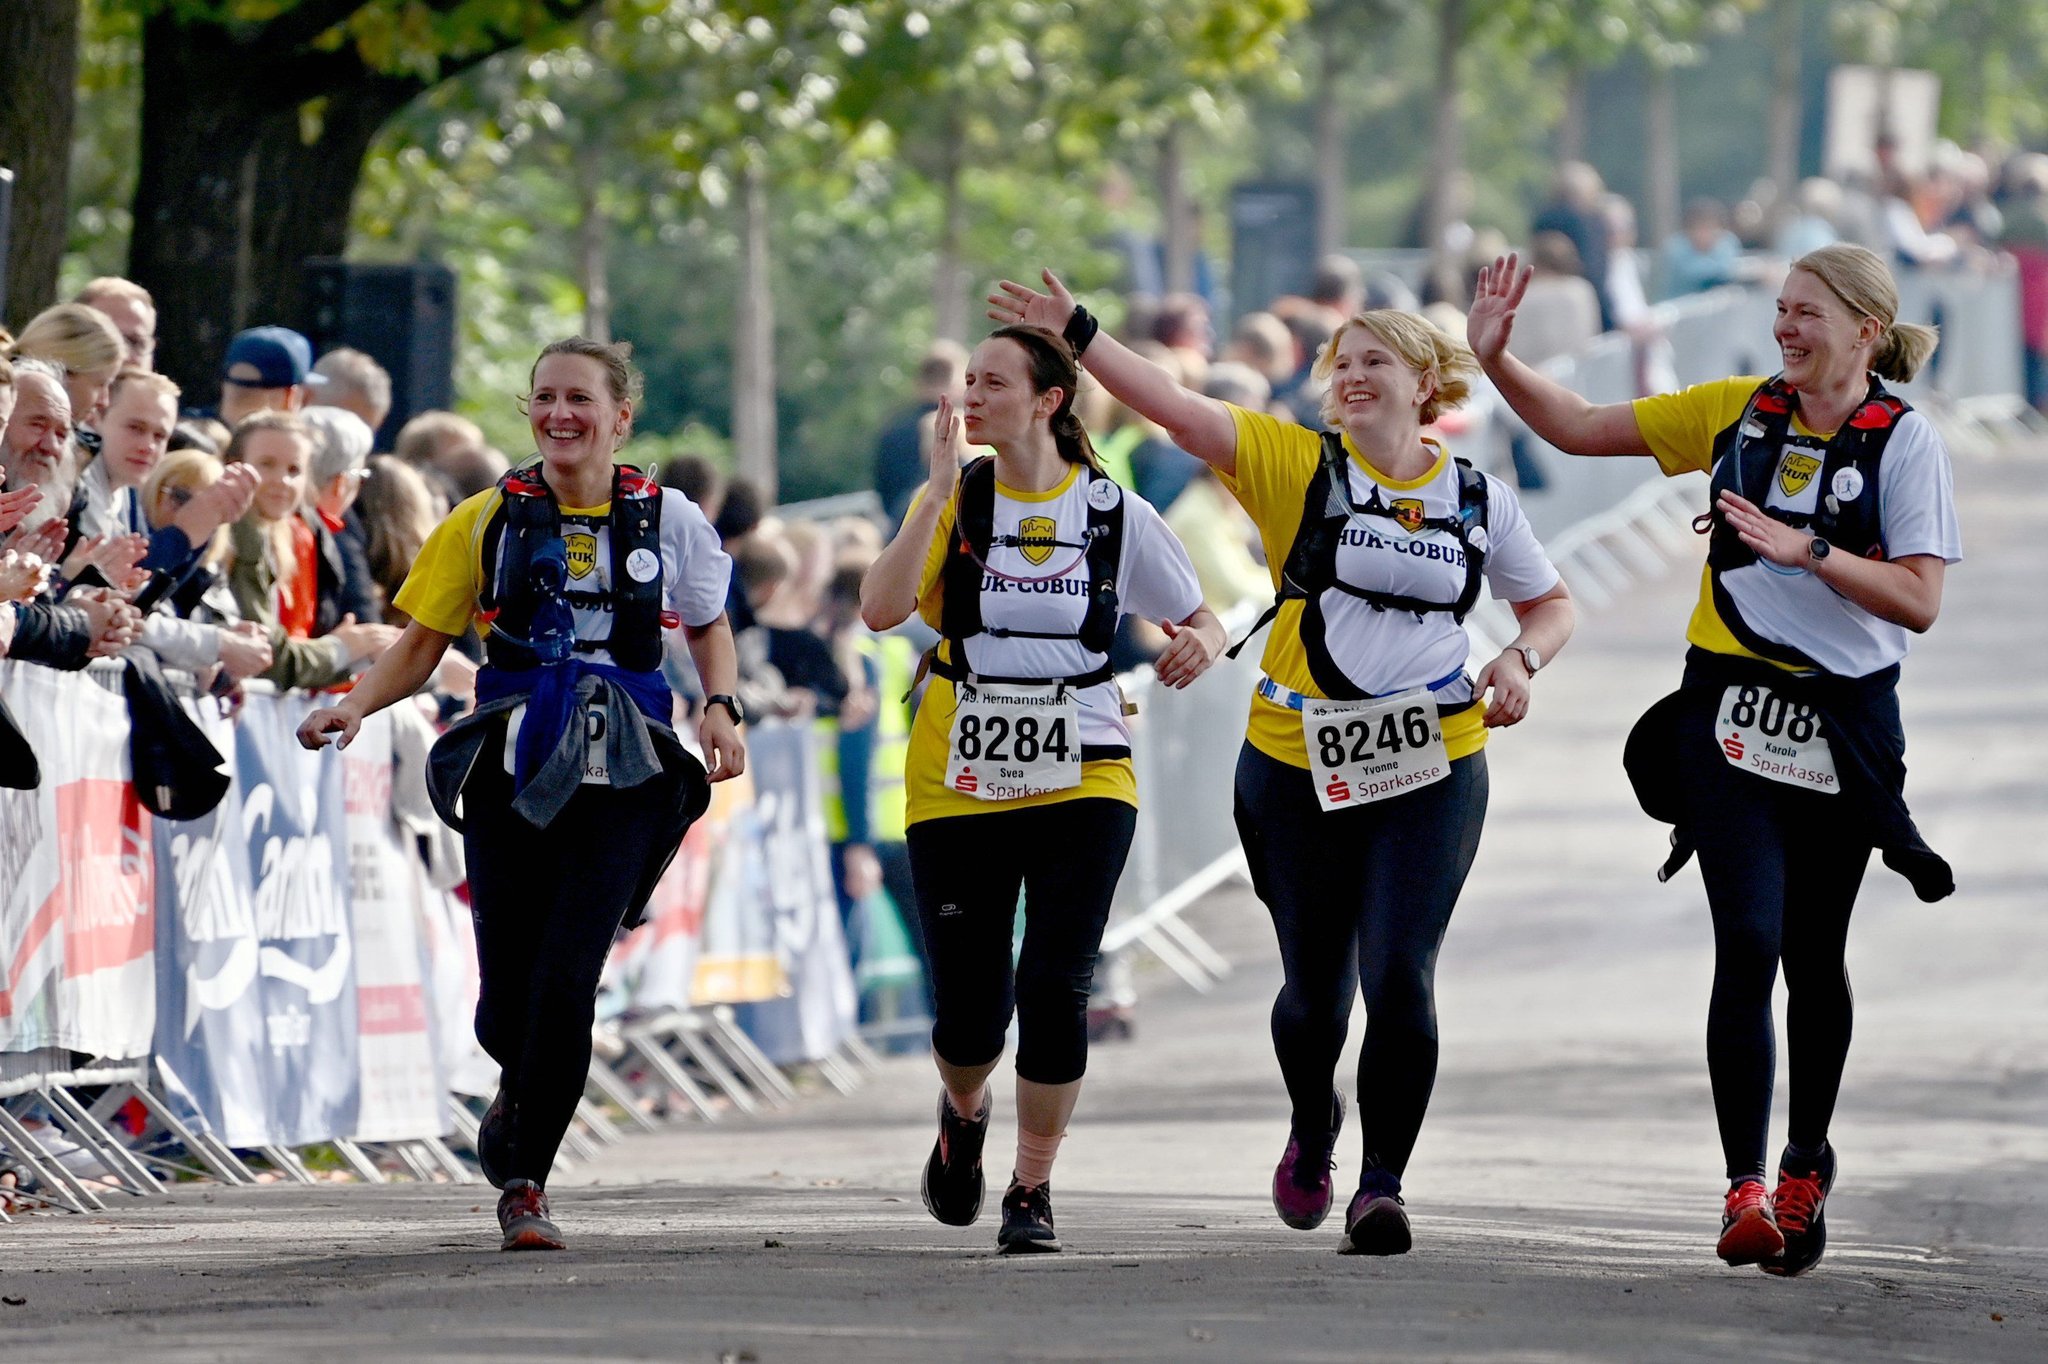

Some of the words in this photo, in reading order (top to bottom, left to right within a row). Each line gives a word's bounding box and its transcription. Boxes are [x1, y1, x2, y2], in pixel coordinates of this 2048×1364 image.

[1781, 465, 1809, 480] HUK
[1338, 529, 1466, 568] HUK-COBUR
[980, 575, 1090, 597] UK-COBUR
[1731, 686, 1823, 743] 808
[958, 714, 1069, 762] 8284
[1317, 706, 1430, 768] 8246
[1765, 742, 1797, 758] Karola
[1071, 753, 1080, 762] W
[1363, 761, 1399, 775] Yvonne
[1751, 753, 1834, 786] Sparkasse
[1000, 767, 1024, 778] Svea
[1358, 766, 1440, 797] Sparkasse
